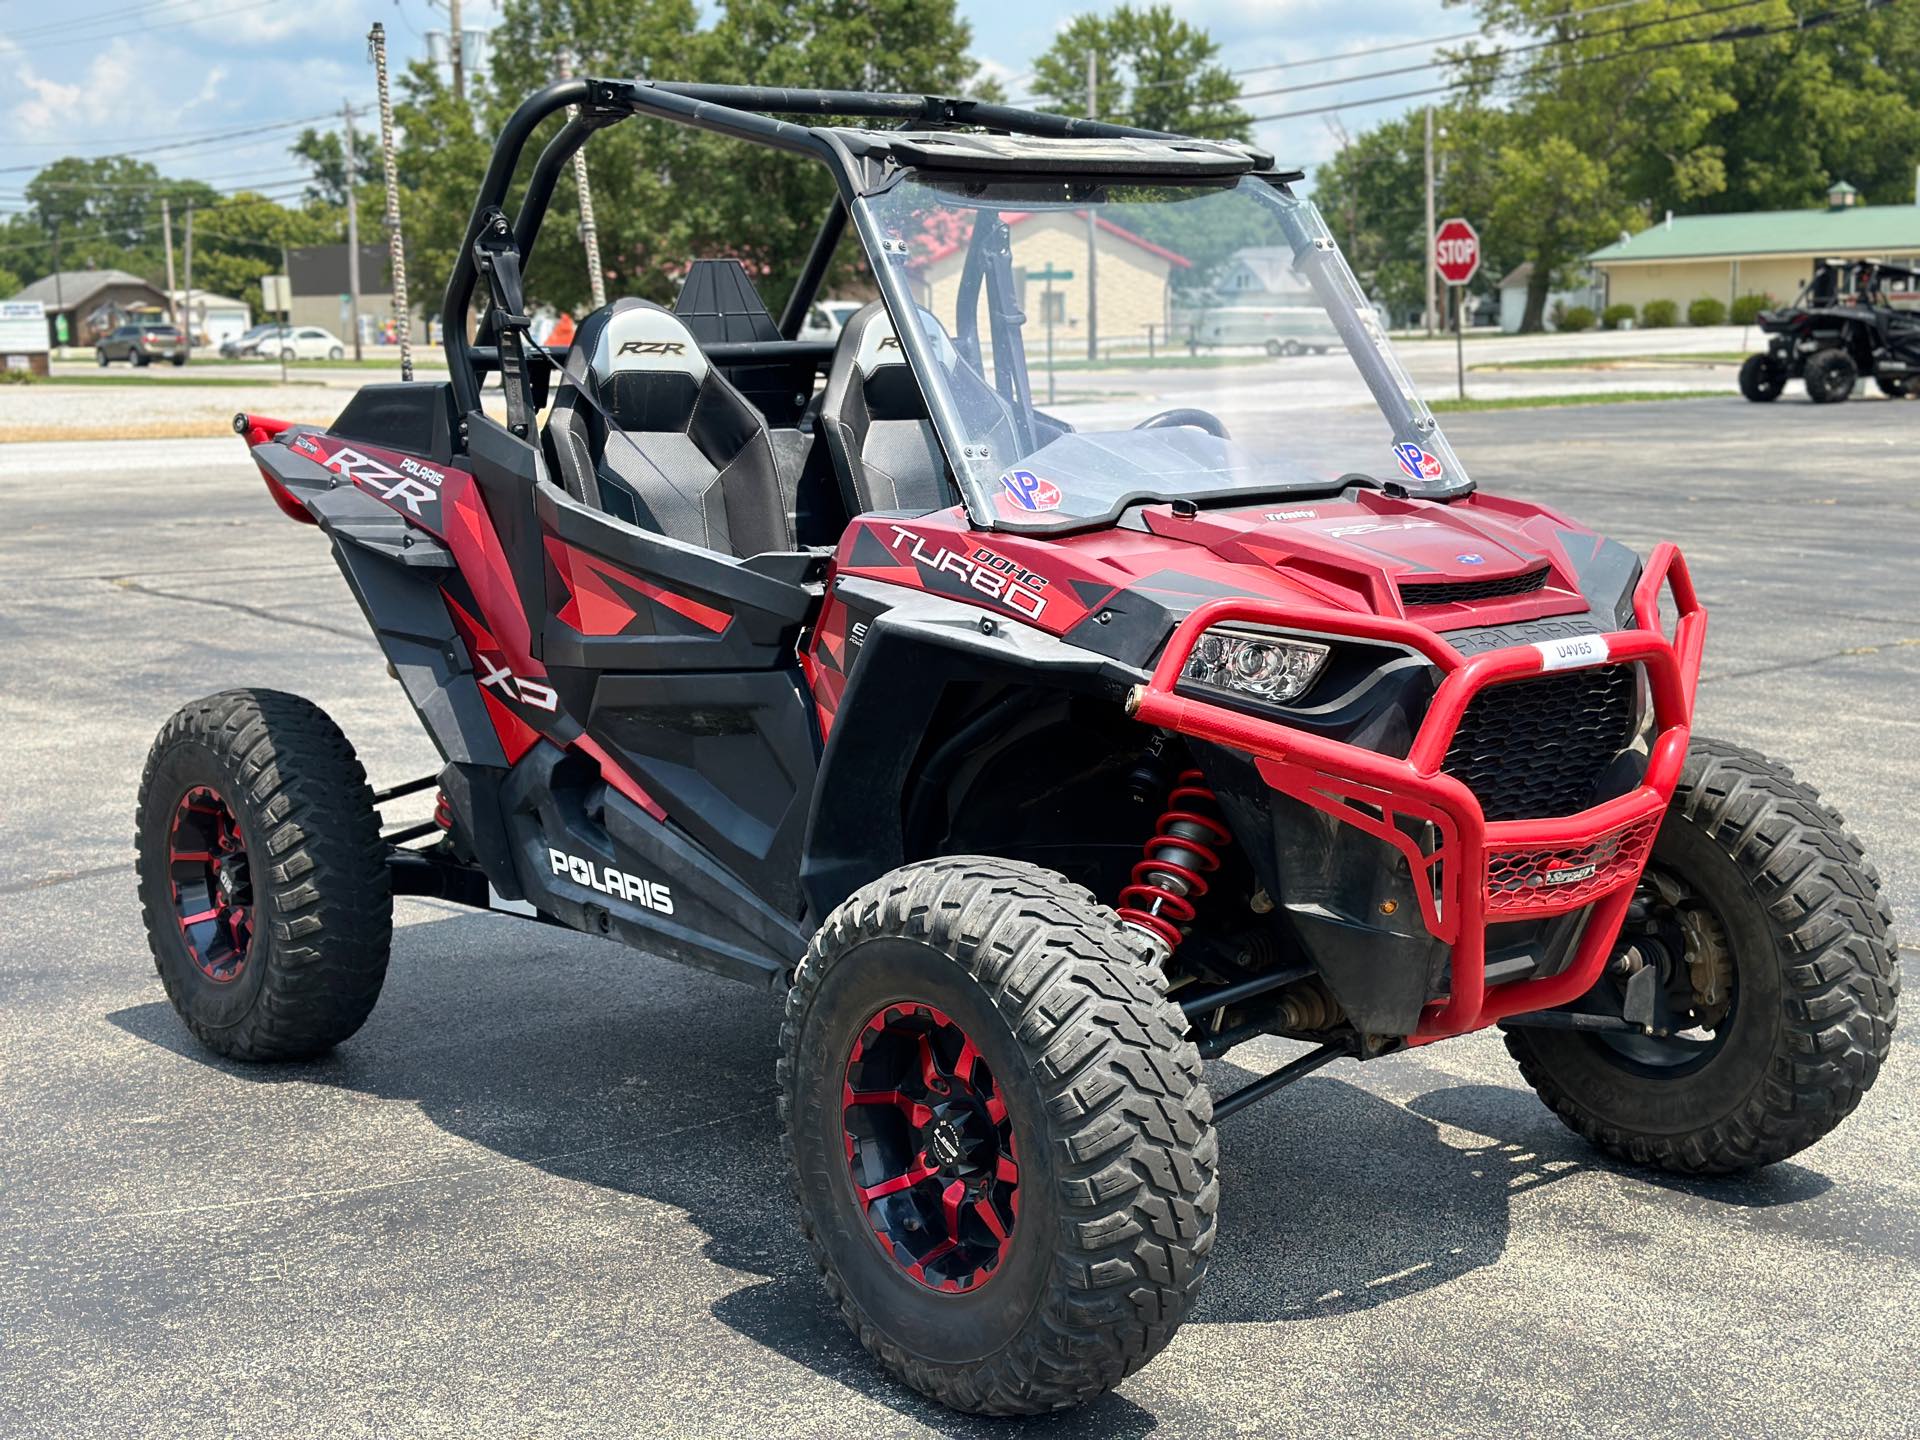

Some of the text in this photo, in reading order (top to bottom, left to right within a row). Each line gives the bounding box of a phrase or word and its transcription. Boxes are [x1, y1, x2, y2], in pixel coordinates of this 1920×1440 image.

[1438, 239, 1474, 265] STOP
[617, 341, 686, 356] RZR
[400, 457, 445, 487] POLARIS
[1393, 443, 1423, 480] VP
[322, 447, 437, 517] RZR
[1000, 470, 1038, 511] VP
[890, 525, 1048, 620] TURBO
[971, 548, 1050, 592] DOHC
[1556, 641, 1593, 659] U4V65
[548, 847, 674, 915] POLARIS
